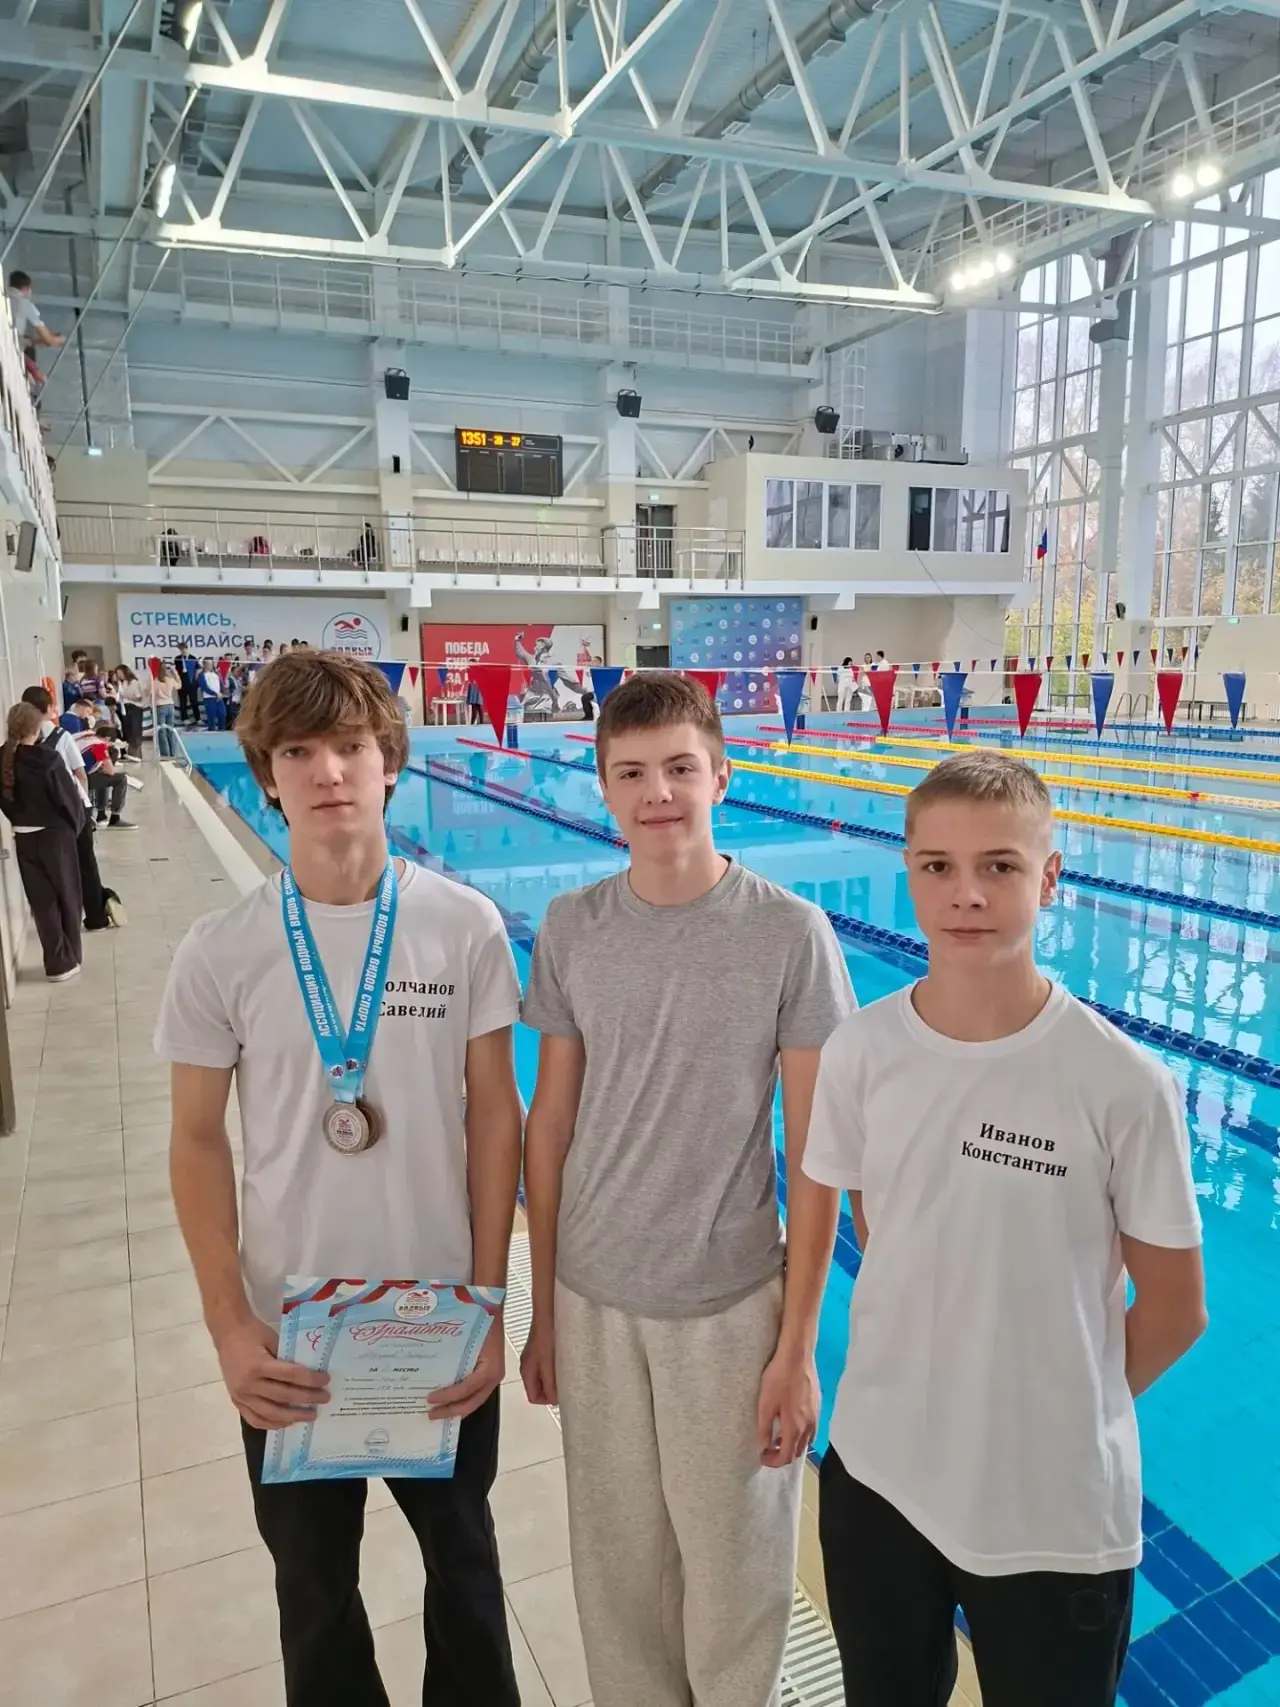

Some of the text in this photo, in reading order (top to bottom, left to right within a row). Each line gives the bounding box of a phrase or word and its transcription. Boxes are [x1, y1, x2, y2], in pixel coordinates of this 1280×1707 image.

[130, 612, 236, 628] СТРЕМИСЬ,
[445, 641, 490, 656] ПОБЕДА
[287, 897, 301, 927] ВИДОВ
[292, 930, 313, 971] ВОДНЫХ
[372, 913, 389, 955] ВОДНЫХ
[363, 957, 380, 992] ВИДОВ
[385, 980, 456, 996] олчанов
[303, 974, 333, 1037] АССОЦИАЦИЯ
[354, 993, 372, 1032] СПОРТА
[979, 1122, 1056, 1152] Иванов
[961, 1140, 1068, 1177] Константин
